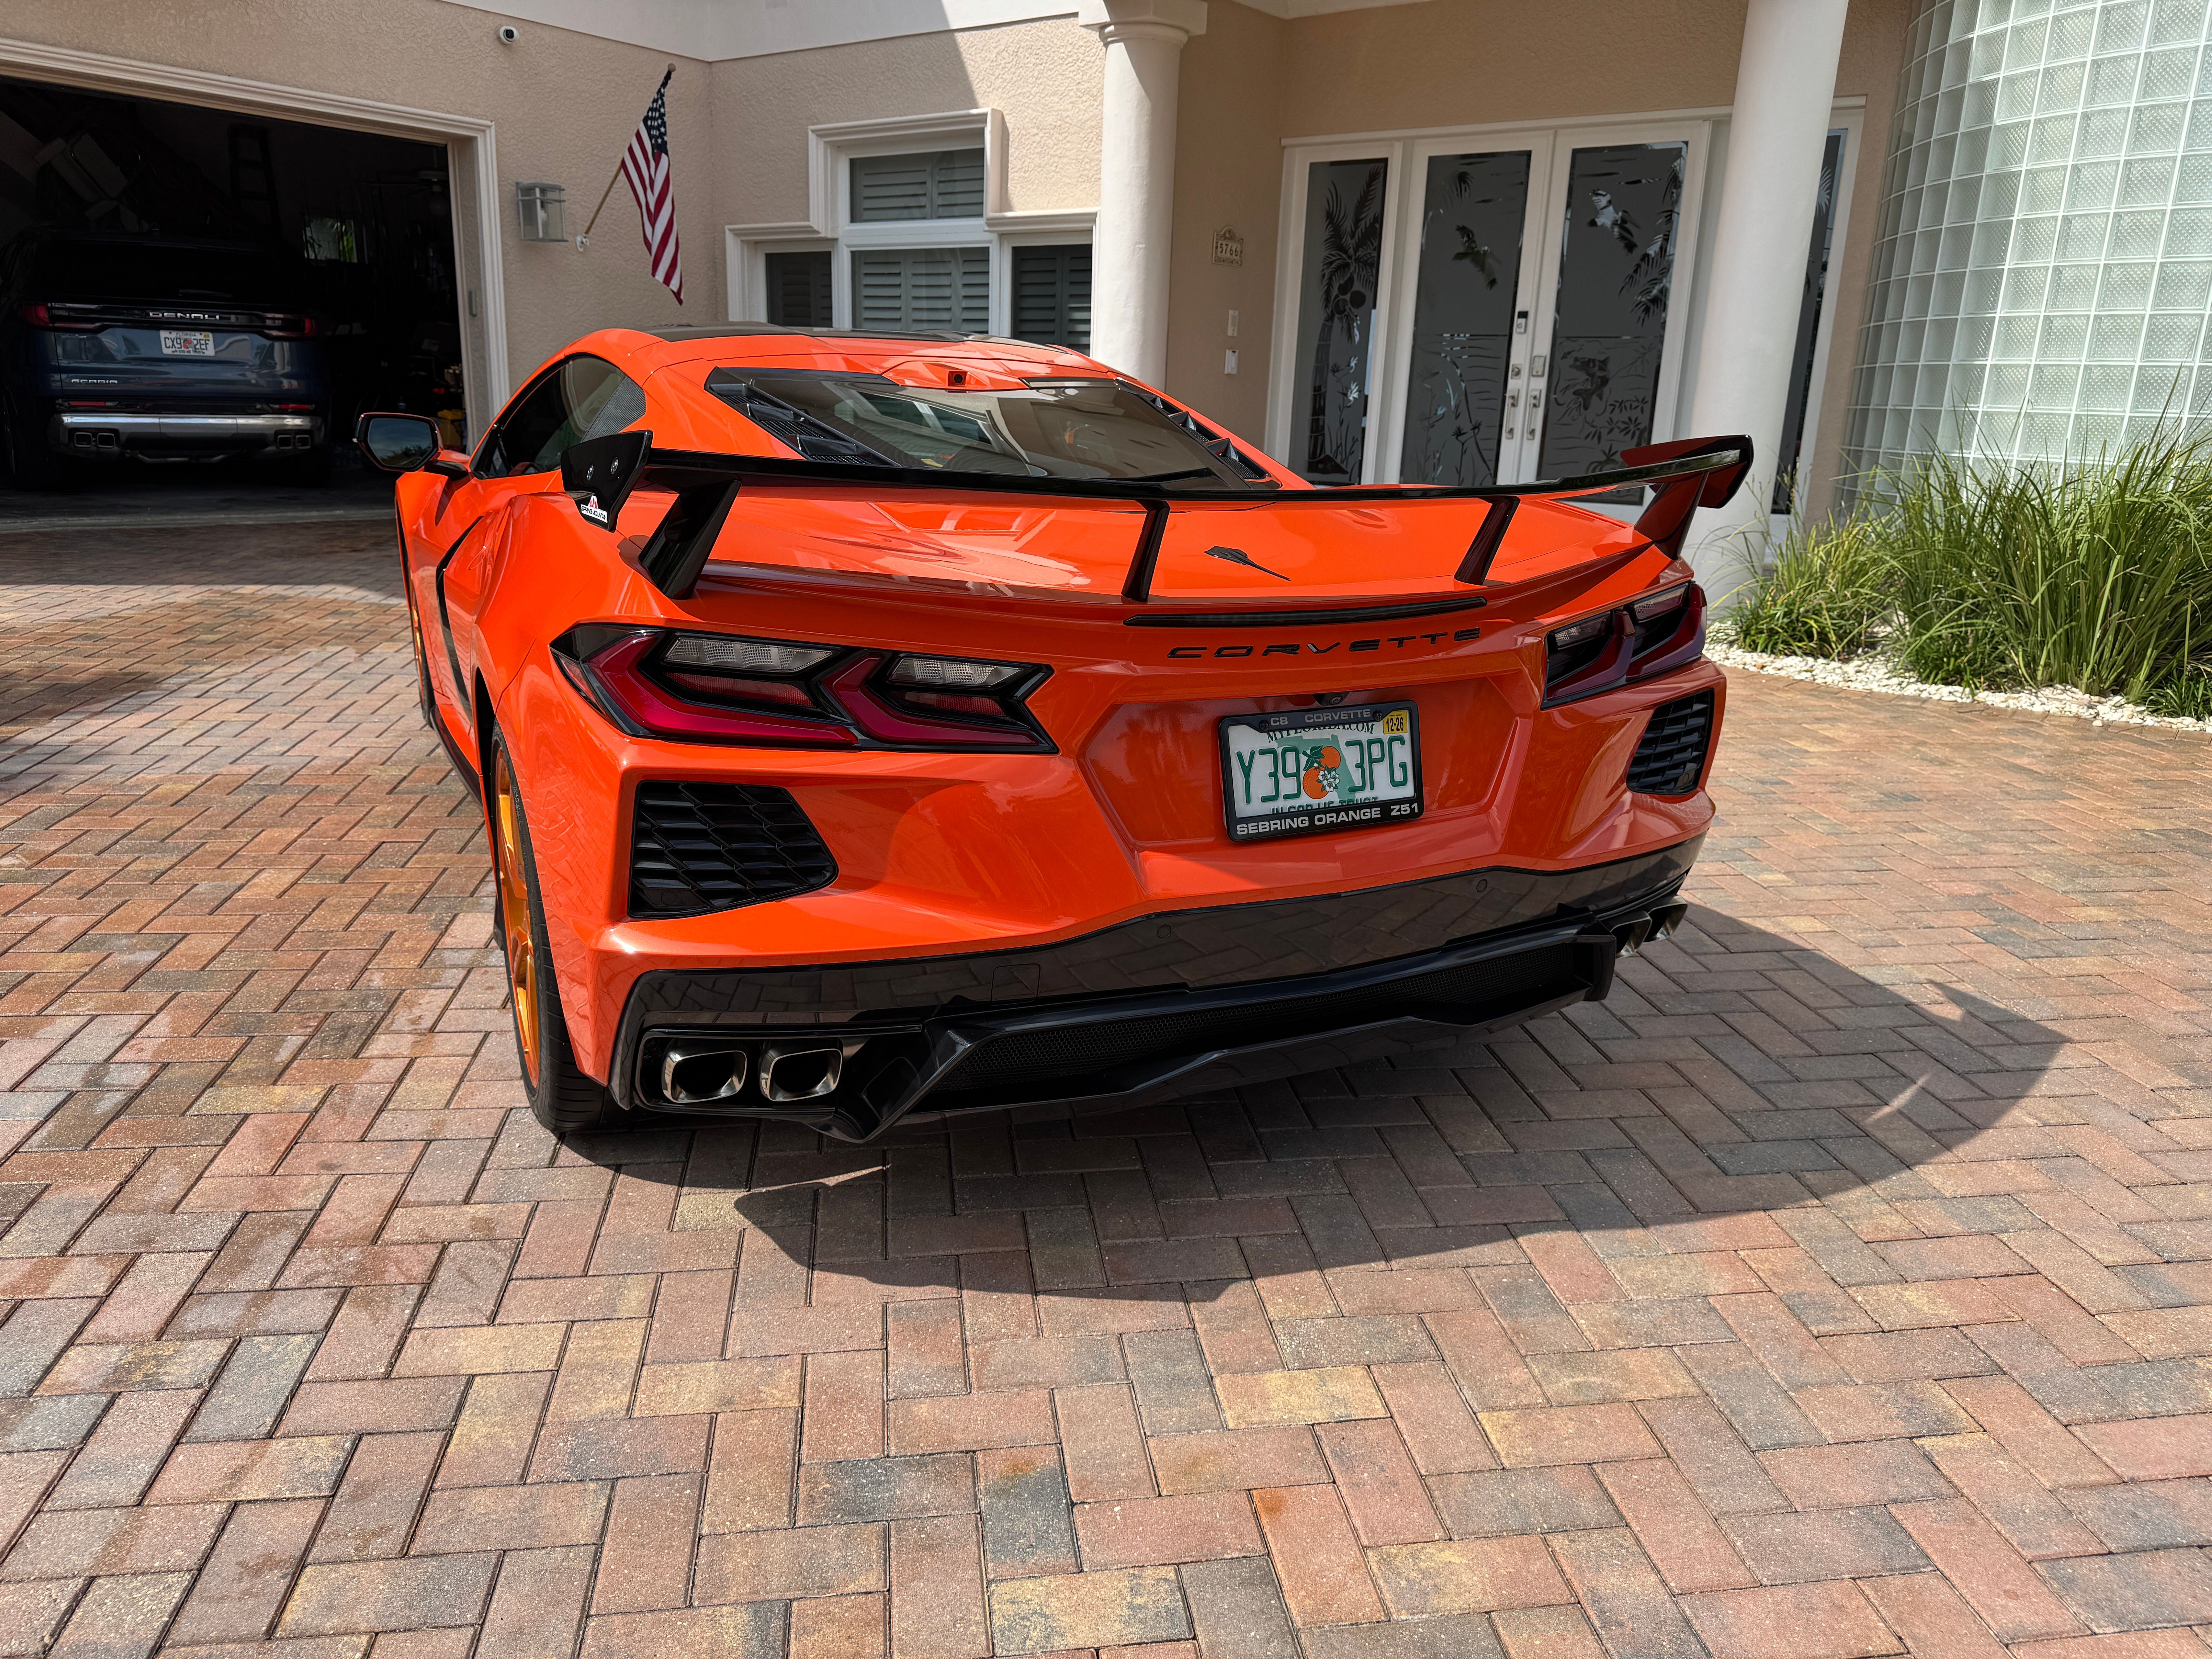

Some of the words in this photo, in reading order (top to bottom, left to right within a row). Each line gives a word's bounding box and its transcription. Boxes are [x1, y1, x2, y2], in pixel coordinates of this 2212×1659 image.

[1219, 243, 1238, 257] 5766
[149, 312, 220, 320] DENALI
[164, 337, 182, 349] CX9
[192, 338, 210, 350] 2EF
[1166, 627, 1481, 658] CORVETTE
[1270, 716, 1288, 726] C8
[1305, 709, 1371, 723] CORVETTE
[1236, 746, 1302, 804] Y39
[1345, 735, 1408, 793] 3PG
[1237, 814, 1309, 835] SEBRING
[1314, 807, 1381, 825] ORANGE
[1391, 803, 1419, 816] Z51
